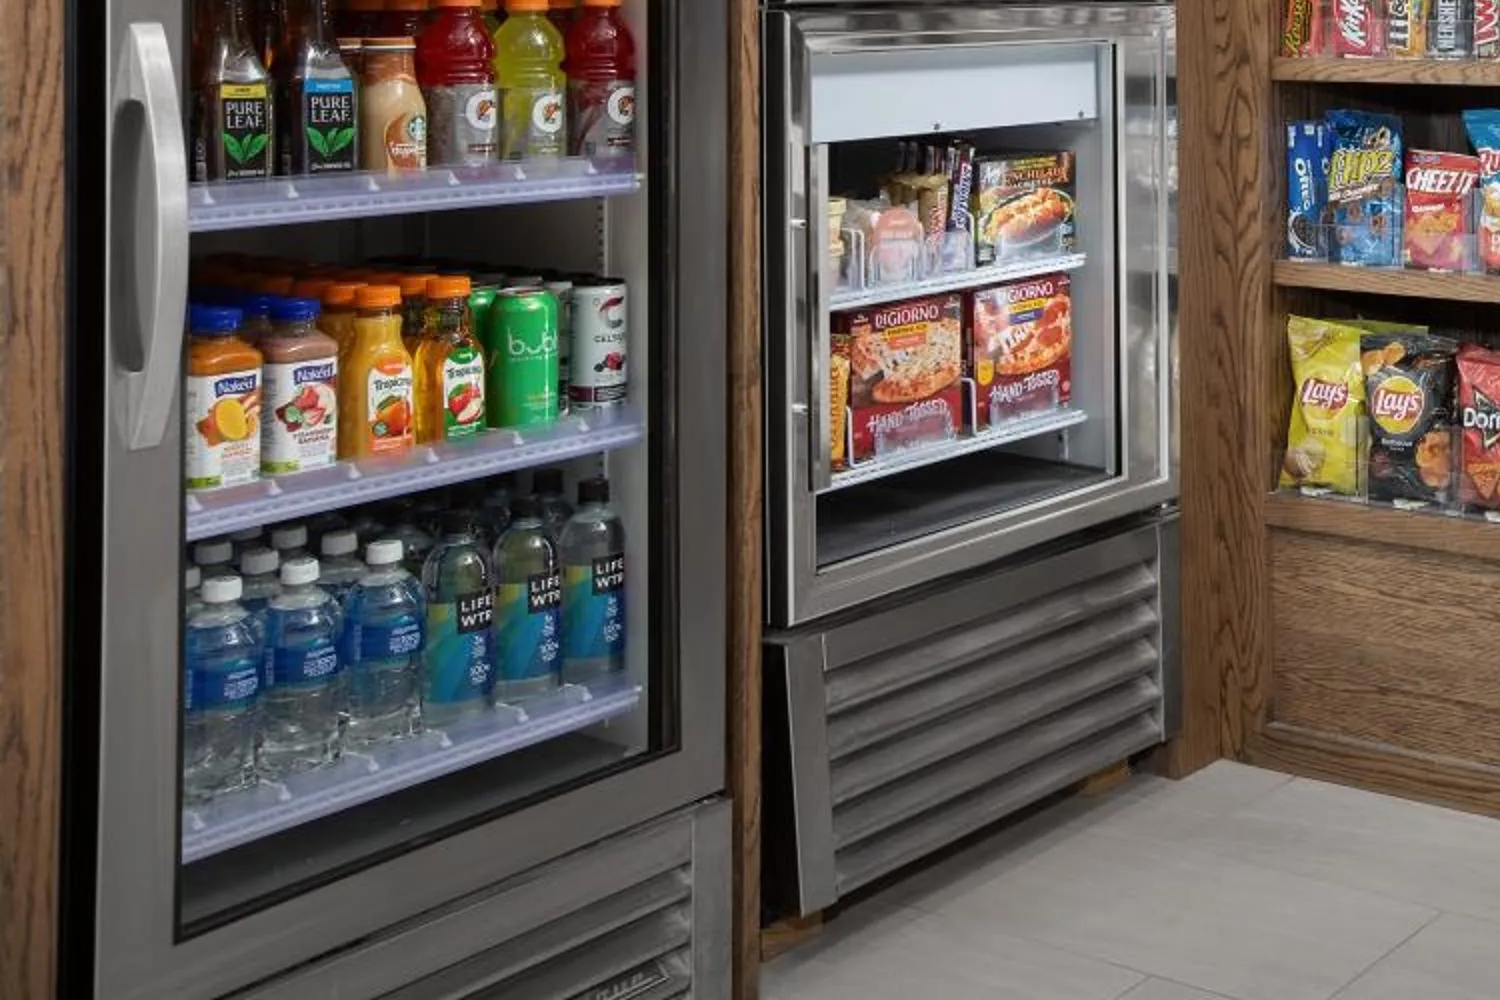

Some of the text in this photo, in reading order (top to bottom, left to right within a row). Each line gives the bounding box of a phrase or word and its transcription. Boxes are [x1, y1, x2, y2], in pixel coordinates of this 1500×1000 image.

[226, 101, 263, 115] PURE
[311, 96, 350, 109] PURE
[226, 115, 264, 129] LEAF
[311, 109, 350, 123] LEAF
[1294, 157, 1312, 212] OREO
[506, 327, 558, 355] bubl
[297, 366, 333, 381] Naked
[446, 366, 482, 379] Tropican
[217, 379, 254, 395] Naked
[374, 378, 412, 391] Tropican
[989, 370, 1060, 403] HAND-TOSSED
[1302, 377, 1349, 410] Lay's
[1375, 388, 1420, 421] Lay's
[866, 398, 948, 434] HAND-TOSSED
[596, 557, 624, 575] LIFE
[531, 575, 560, 593] LIFE
[596, 571, 624, 589] WTR
[461, 594, 492, 613] LIFE
[531, 590, 561, 607] WTR
[461, 609, 492, 628] WTR
